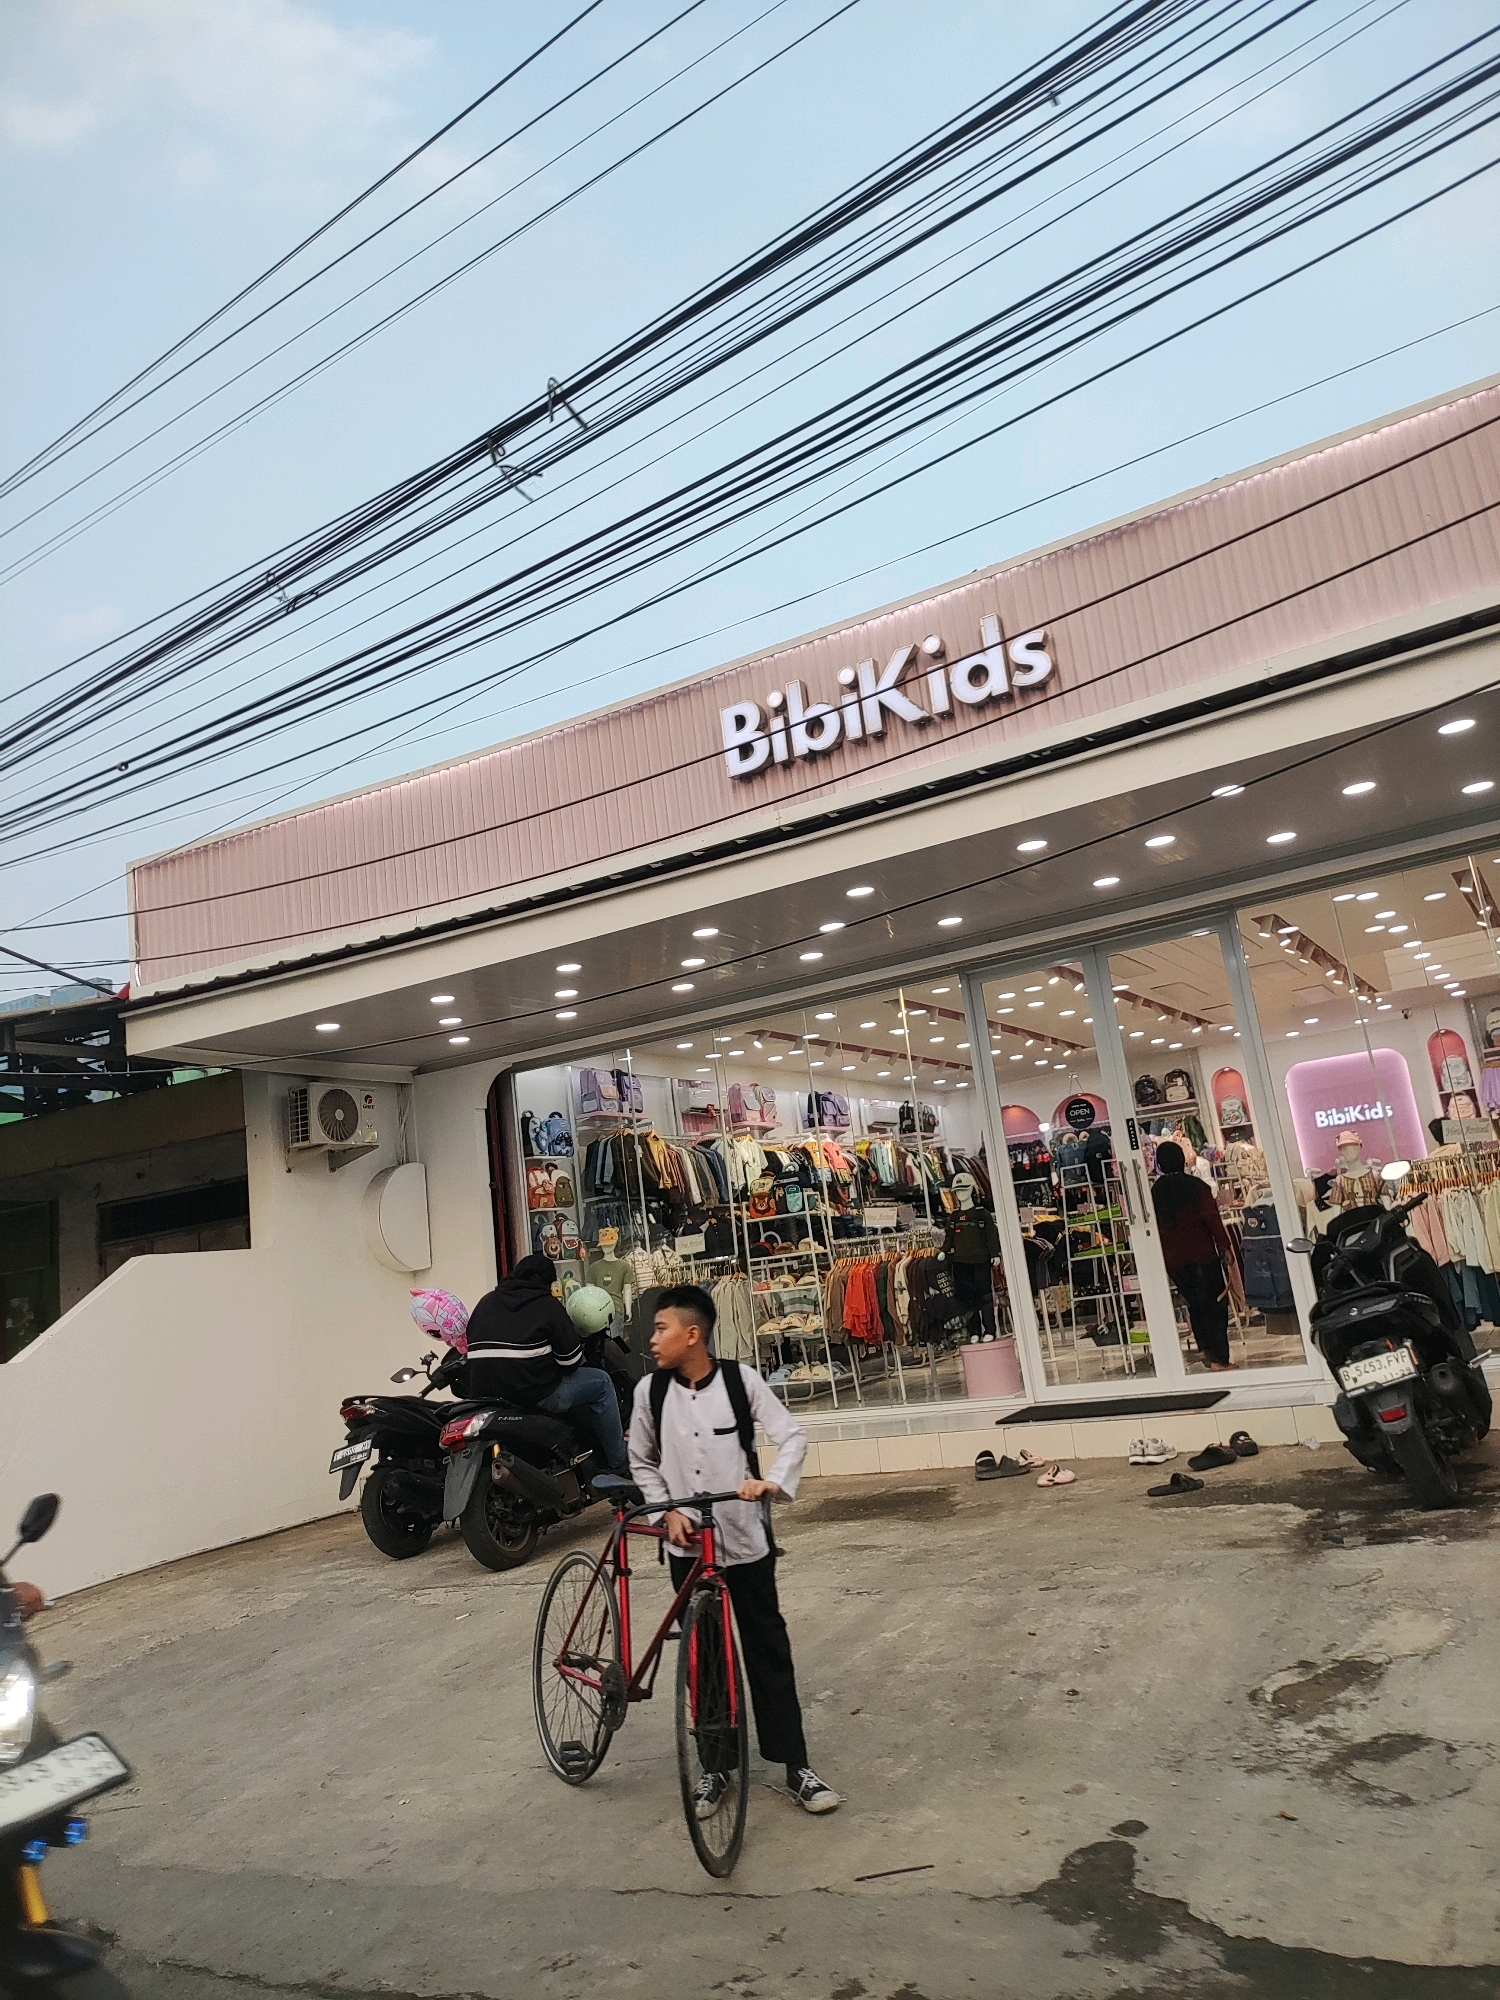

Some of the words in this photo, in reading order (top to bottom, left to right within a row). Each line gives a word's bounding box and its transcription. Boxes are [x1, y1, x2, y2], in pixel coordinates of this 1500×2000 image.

[720, 612, 1054, 779] BibiKids
[1070, 1108, 1090, 1117] OPEN
[1315, 1101, 1393, 1128] BibiKids
[1354, 1359, 1383, 1377] 5453
[1386, 1351, 1407, 1366] FVF
